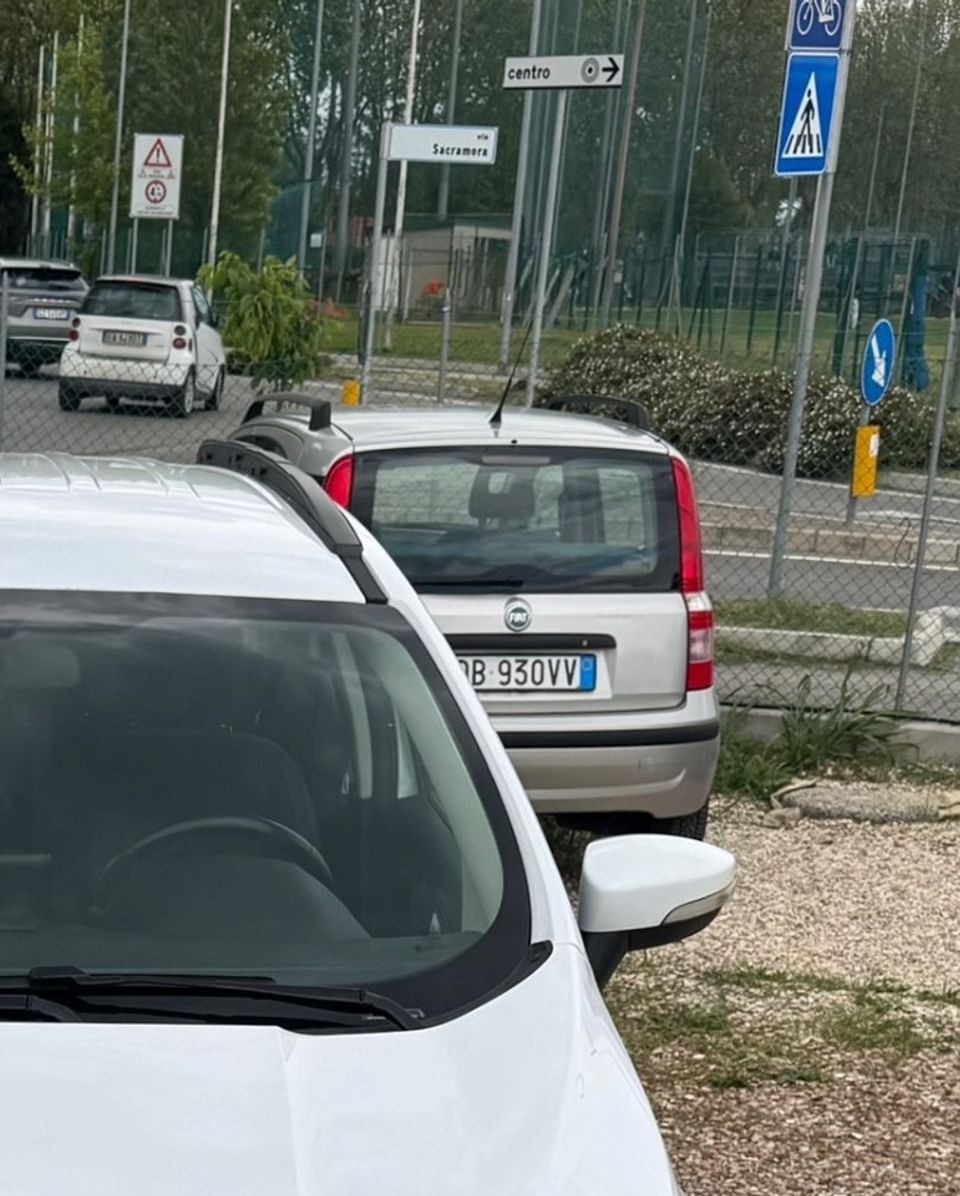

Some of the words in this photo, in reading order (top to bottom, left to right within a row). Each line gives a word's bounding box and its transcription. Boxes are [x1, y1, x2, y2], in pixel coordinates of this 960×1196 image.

[508, 64, 551, 80] centro
[432, 143, 488, 156] Sacramora
[509, 611, 528, 623] FIAT
[498, 658, 577, 686] 930VV
